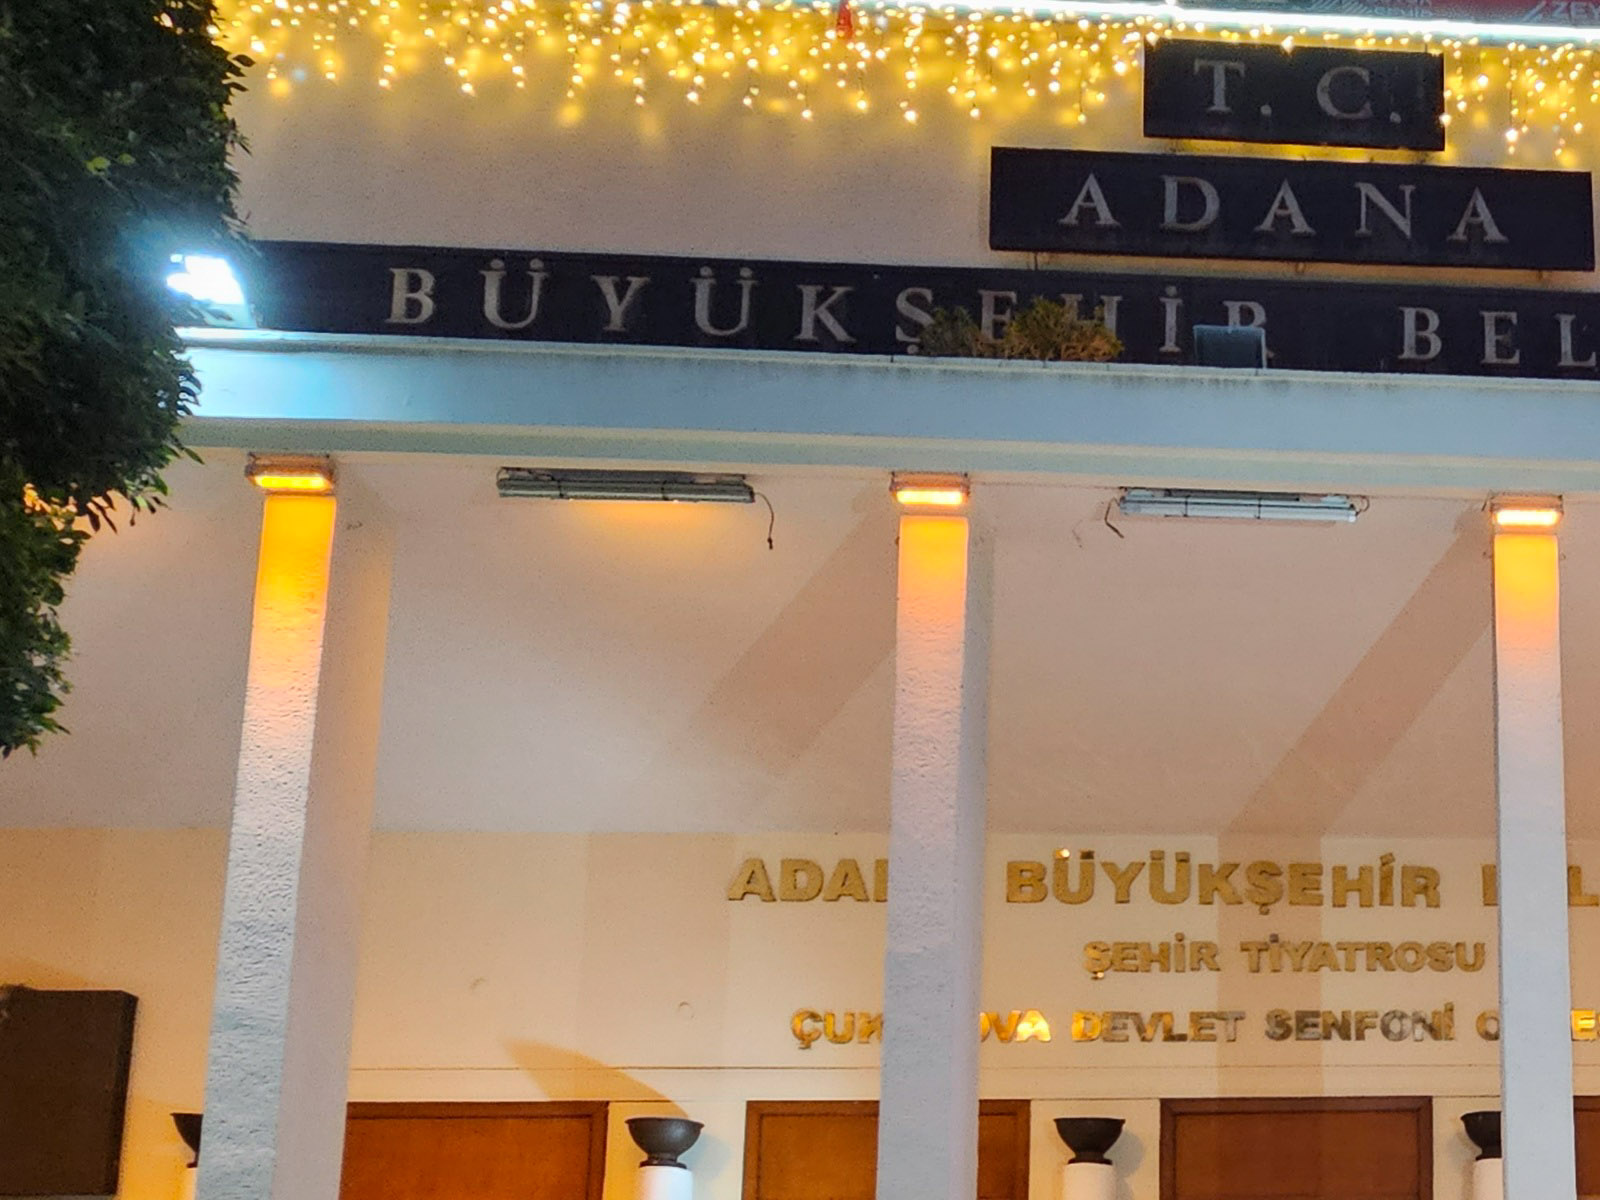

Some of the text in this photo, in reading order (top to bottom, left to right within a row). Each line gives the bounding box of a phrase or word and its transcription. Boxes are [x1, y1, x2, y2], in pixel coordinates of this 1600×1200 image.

[1194, 58, 1402, 123] T. C.
[1058, 173, 1509, 245] ADANA
[726, 857, 888, 903] ADA
[1005, 849, 1441, 916] BÜYÜKŞEHİR
[1083, 932, 1486, 980] ŞEHİR TİYATROSU
[791, 1007, 1053, 1050] ÇUKVA
[1071, 1009, 1246, 1043] DEVLET
[1265, 1001, 1455, 1042] SENFONİ
